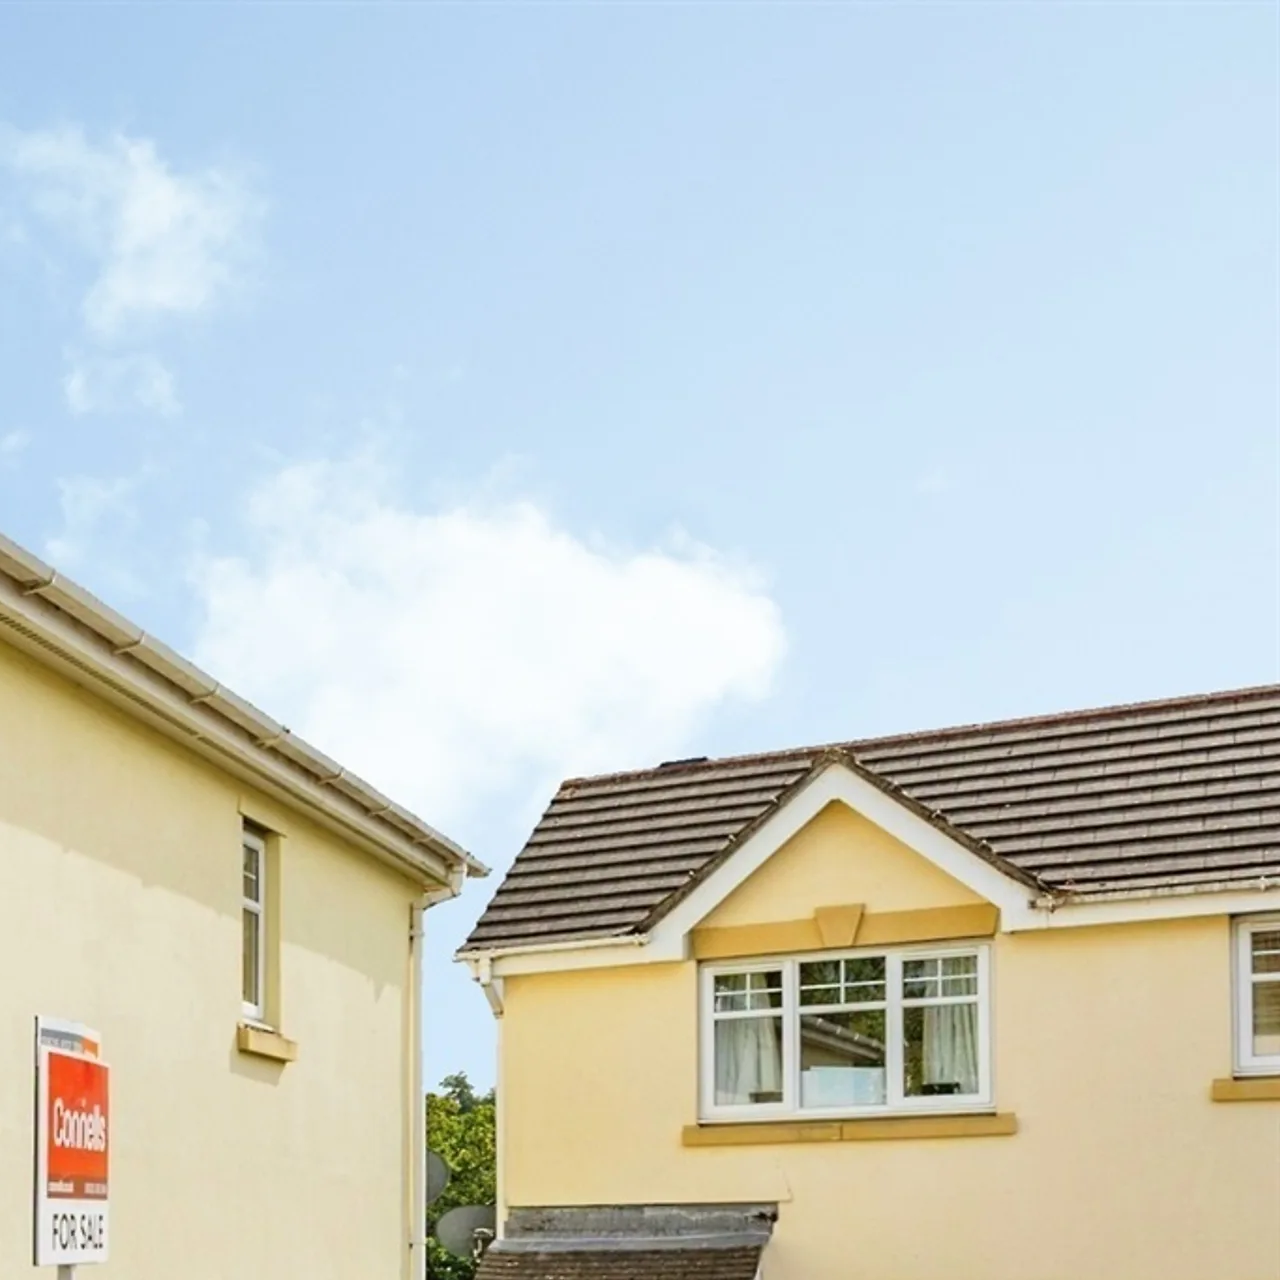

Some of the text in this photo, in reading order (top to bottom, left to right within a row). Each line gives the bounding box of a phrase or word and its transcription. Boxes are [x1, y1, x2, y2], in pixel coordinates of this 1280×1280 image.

[54, 1097, 106, 1152] Connells
[52, 1213, 103, 1250] FOR SALE
